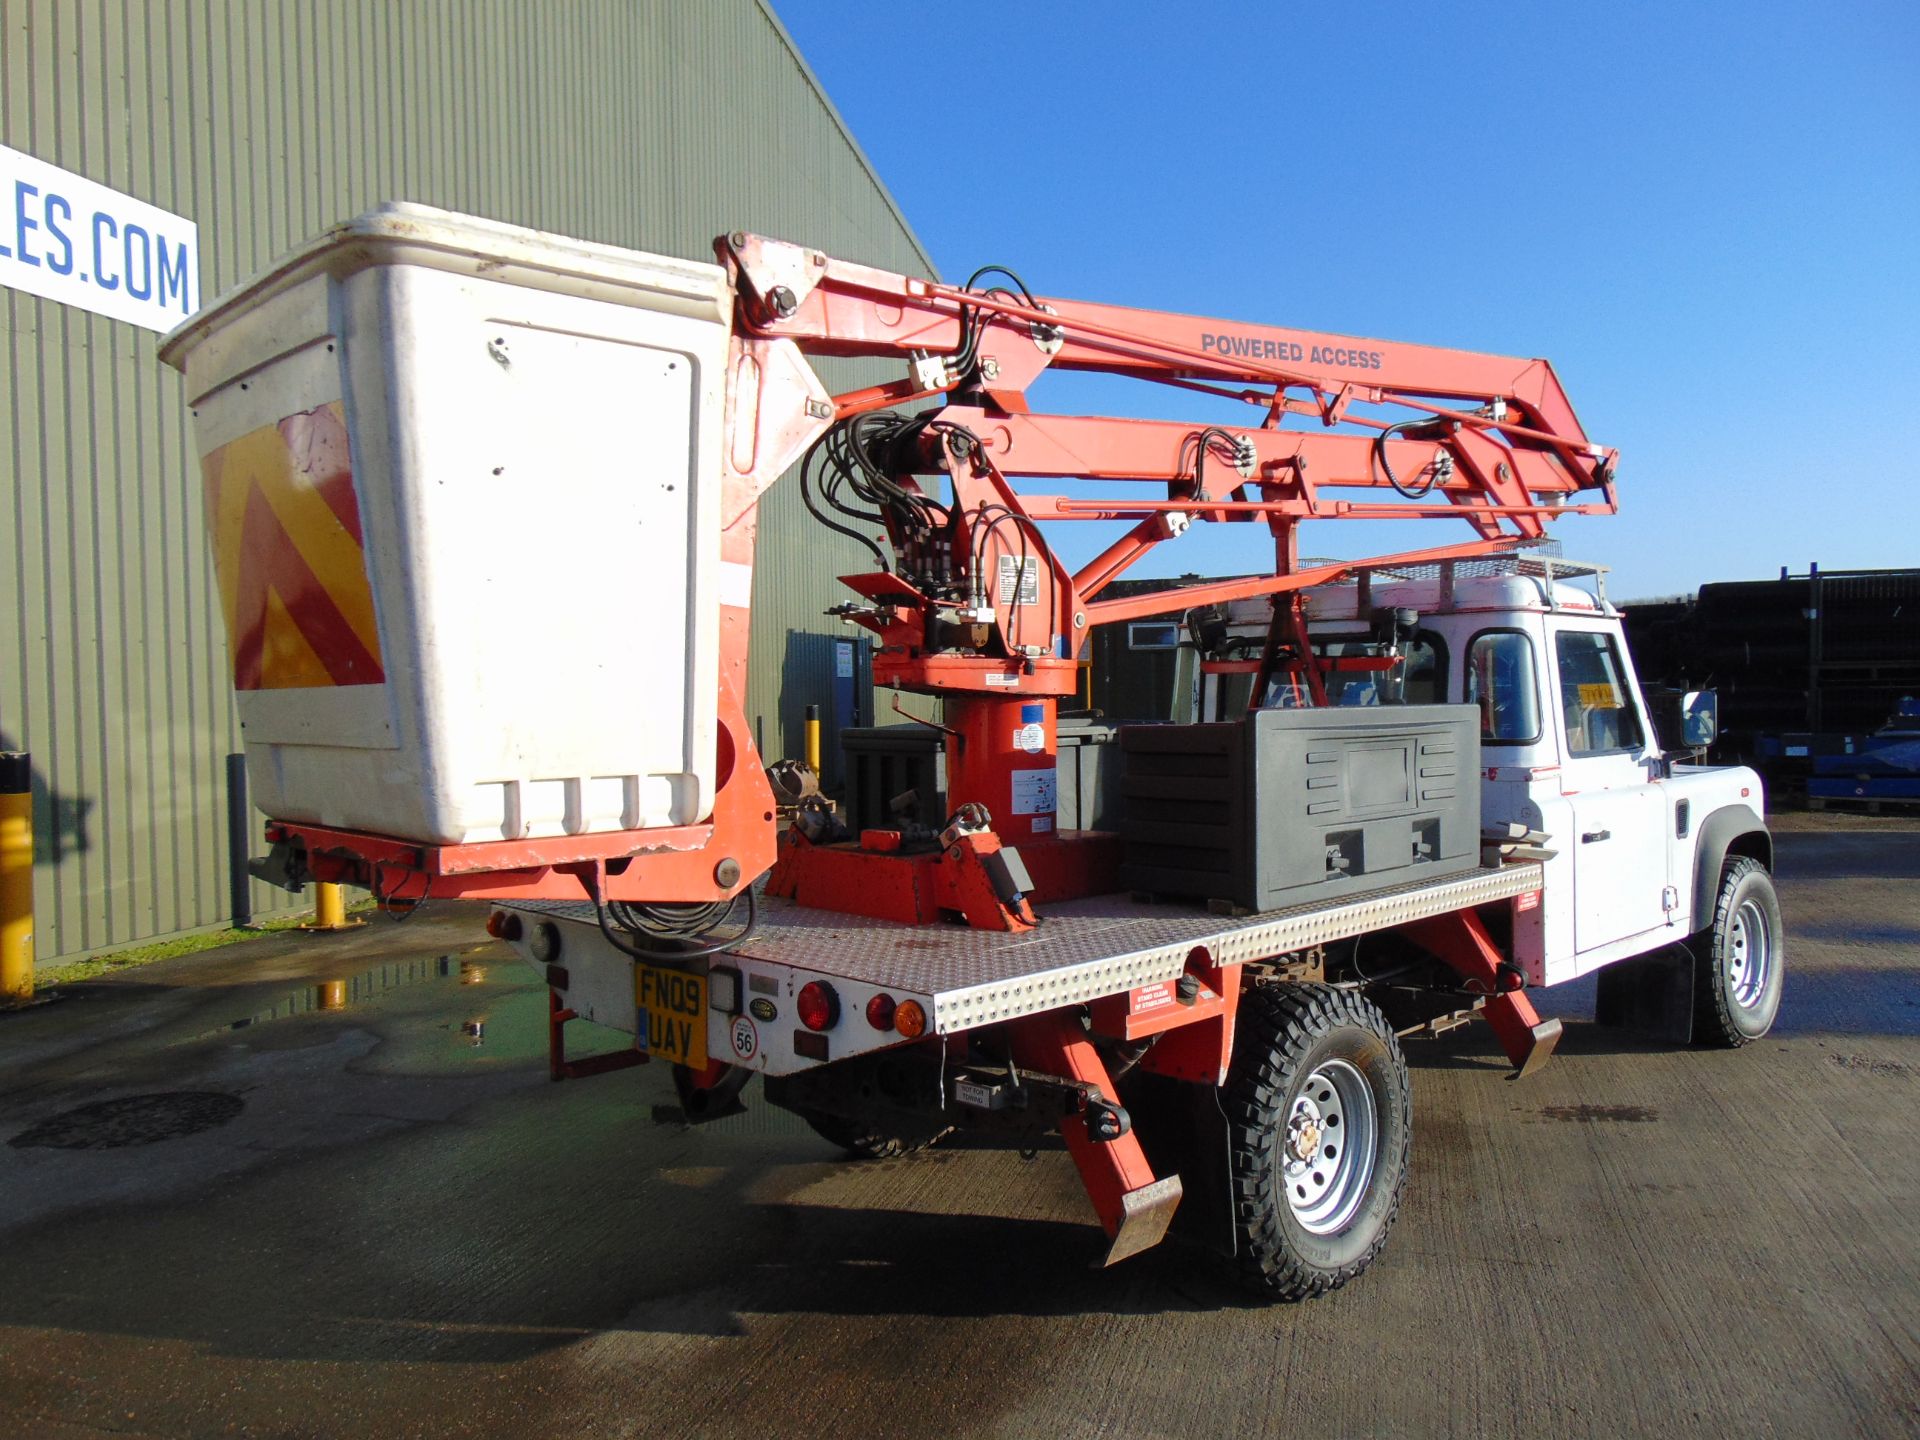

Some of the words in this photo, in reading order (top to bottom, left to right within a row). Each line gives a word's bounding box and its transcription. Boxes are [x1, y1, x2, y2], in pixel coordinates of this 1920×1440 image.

[1201, 333, 1304, 361] POWERED
[1310, 346, 1382, 370] ACCESS
[641, 969, 700, 1017] FN09
[649, 1011, 692, 1058] UAV
[736, 1032, 752, 1053] 56
